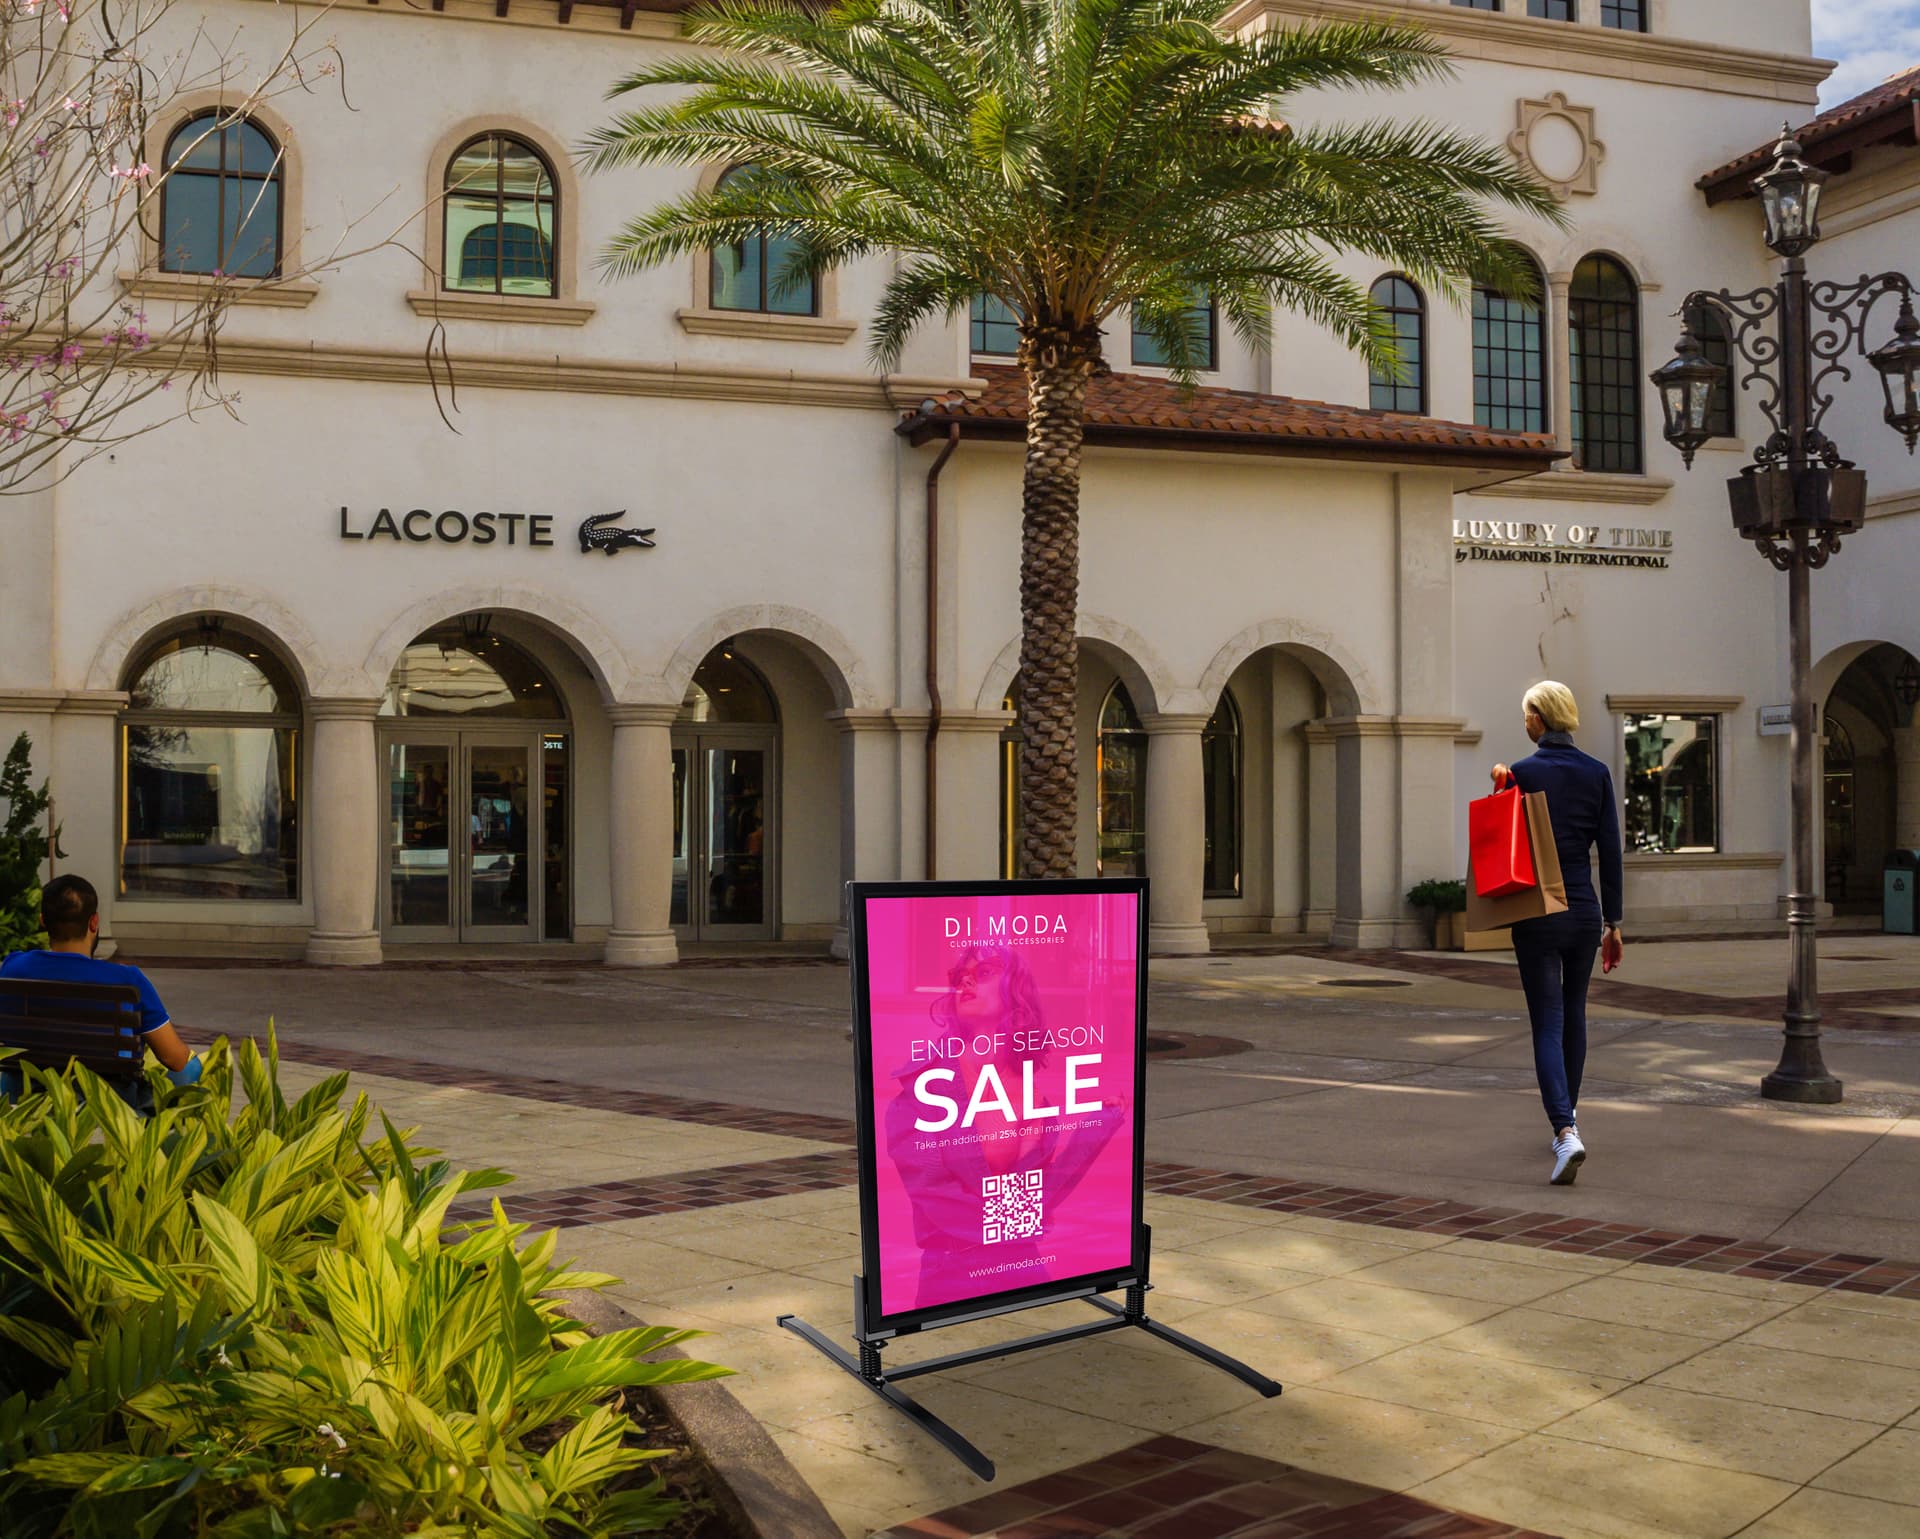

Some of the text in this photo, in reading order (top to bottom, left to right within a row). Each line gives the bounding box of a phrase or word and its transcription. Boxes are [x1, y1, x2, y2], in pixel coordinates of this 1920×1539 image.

[341, 506, 554, 546] LACOSTE
[1453, 520, 1673, 548] LUXURY OF TIME
[1455, 547, 1669, 568] by DIAMONDS INTERNATIONAL
[945, 914, 1068, 938] DI MODA
[950, 939, 995, 948] CLOTHING
[1007, 936, 1065, 946] ACCESSORIES
[911, 1025, 1105, 1062] END OF SEASON
[914, 1053, 1103, 1133] SALE
[914, 1139, 937, 1150] Take
[938, 1138, 950, 1147] an
[952, 1132, 998, 1146] additional
[1000, 1129, 1018, 1140] 25%
[1019, 1125, 1033, 1137] Off
[1034, 1124, 1044, 1135] al
[1045, 1121, 1077, 1133] marked
[968, 1254, 1057, 1278] www.dimoda.com
